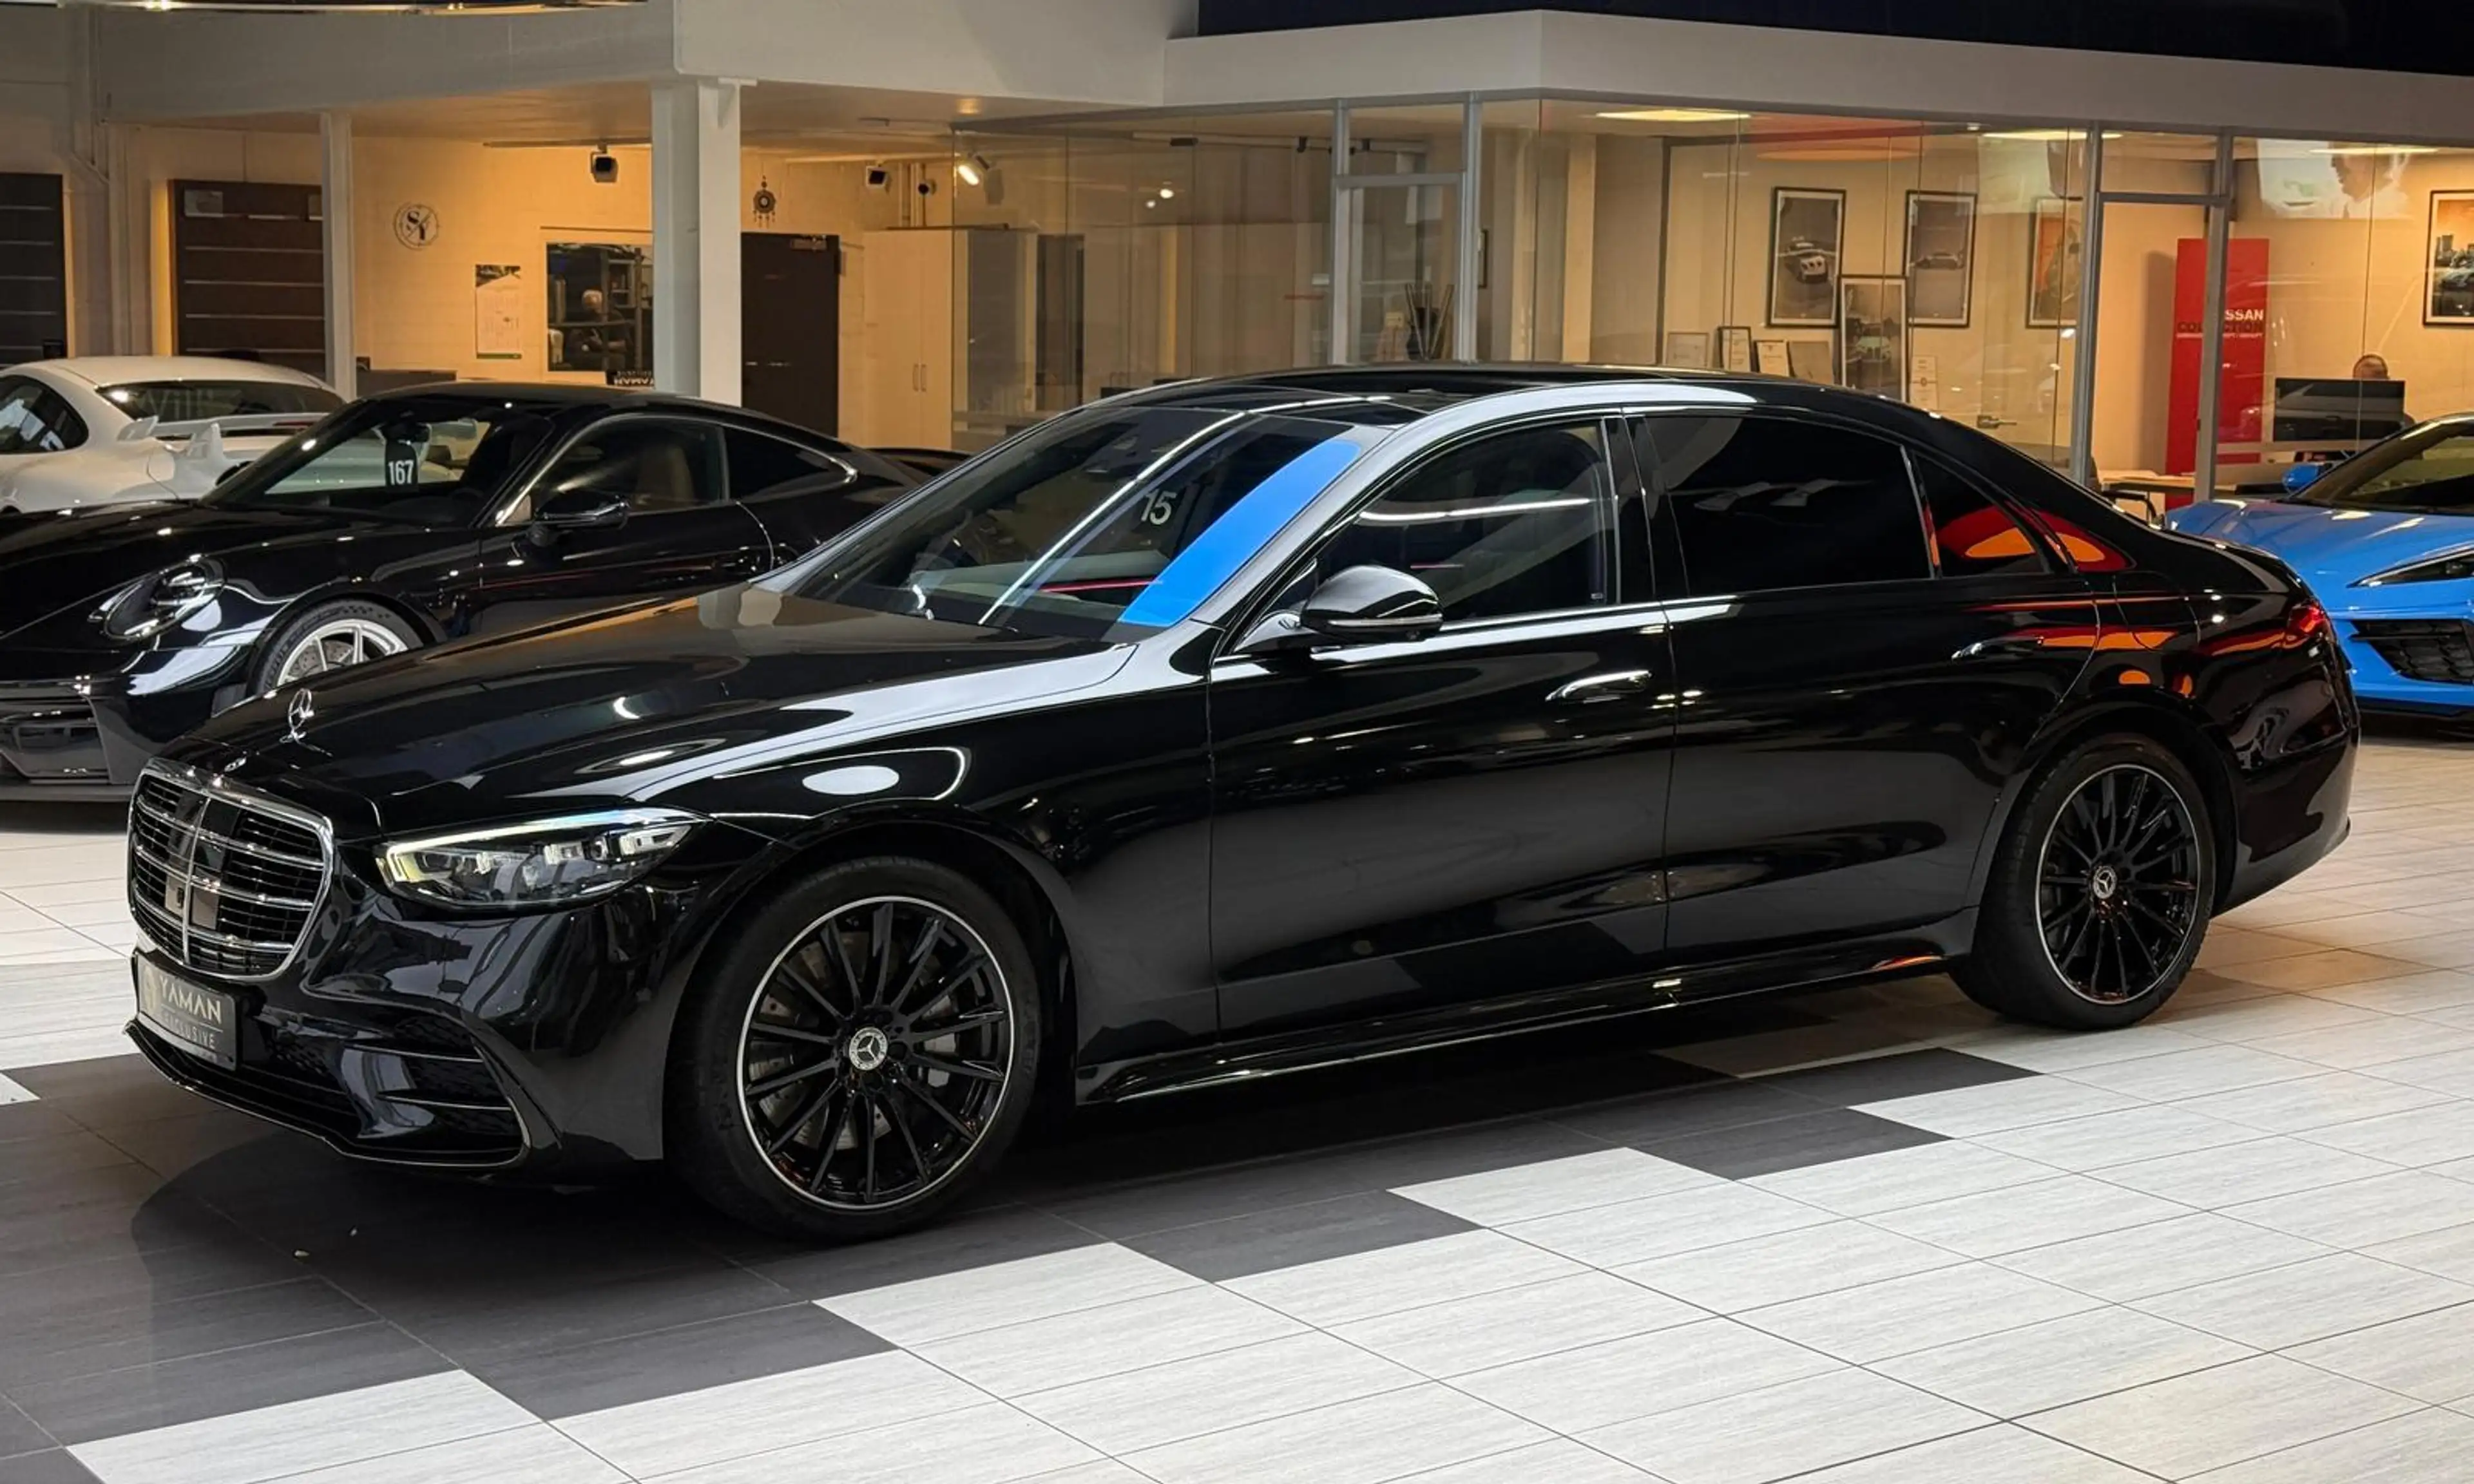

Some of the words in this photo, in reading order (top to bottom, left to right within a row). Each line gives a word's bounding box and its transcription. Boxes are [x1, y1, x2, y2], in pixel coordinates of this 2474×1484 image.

[2225, 309, 2264, 321] SSAN
[388, 460, 414, 485] 167
[1141, 489, 1177, 525] 15
[160, 975, 222, 1025] YAMAN
